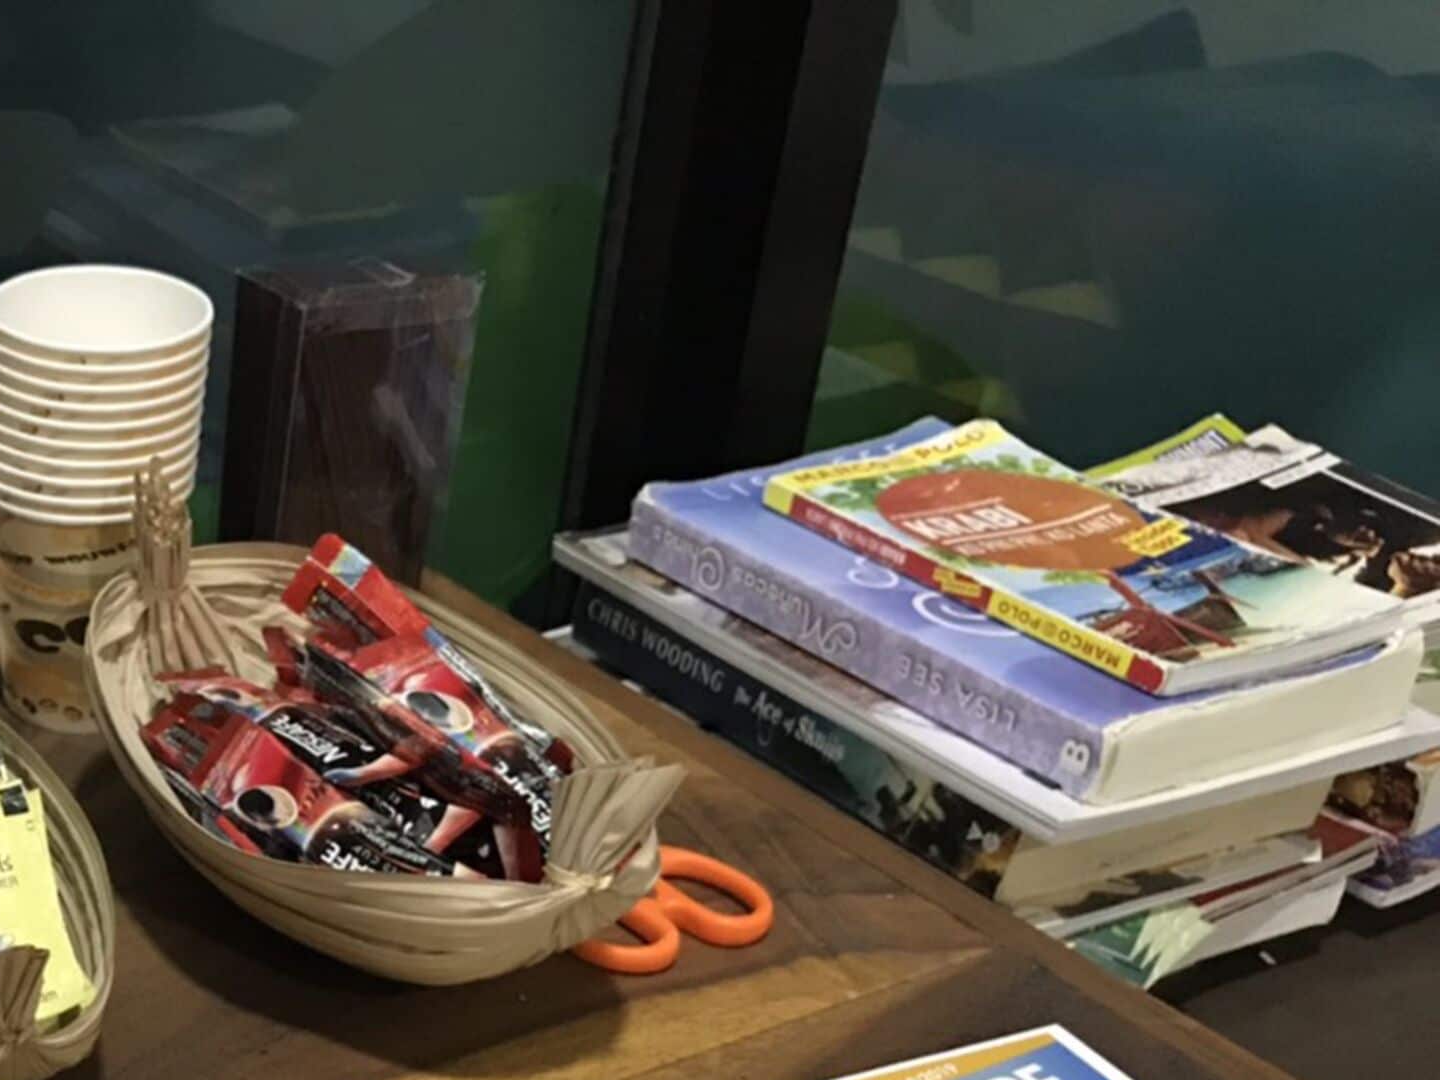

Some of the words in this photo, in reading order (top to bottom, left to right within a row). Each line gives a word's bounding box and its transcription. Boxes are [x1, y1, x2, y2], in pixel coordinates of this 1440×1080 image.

[901, 503, 1033, 542] KRABI
[997, 600, 1040, 630] POLO
[586, 598, 637, 643] CHRIS
[641, 624, 727, 694] WOODING
[1059, 626, 1121, 669] MARCO
[894, 655, 945, 695] SEE
[955, 680, 1021, 731] LISA
